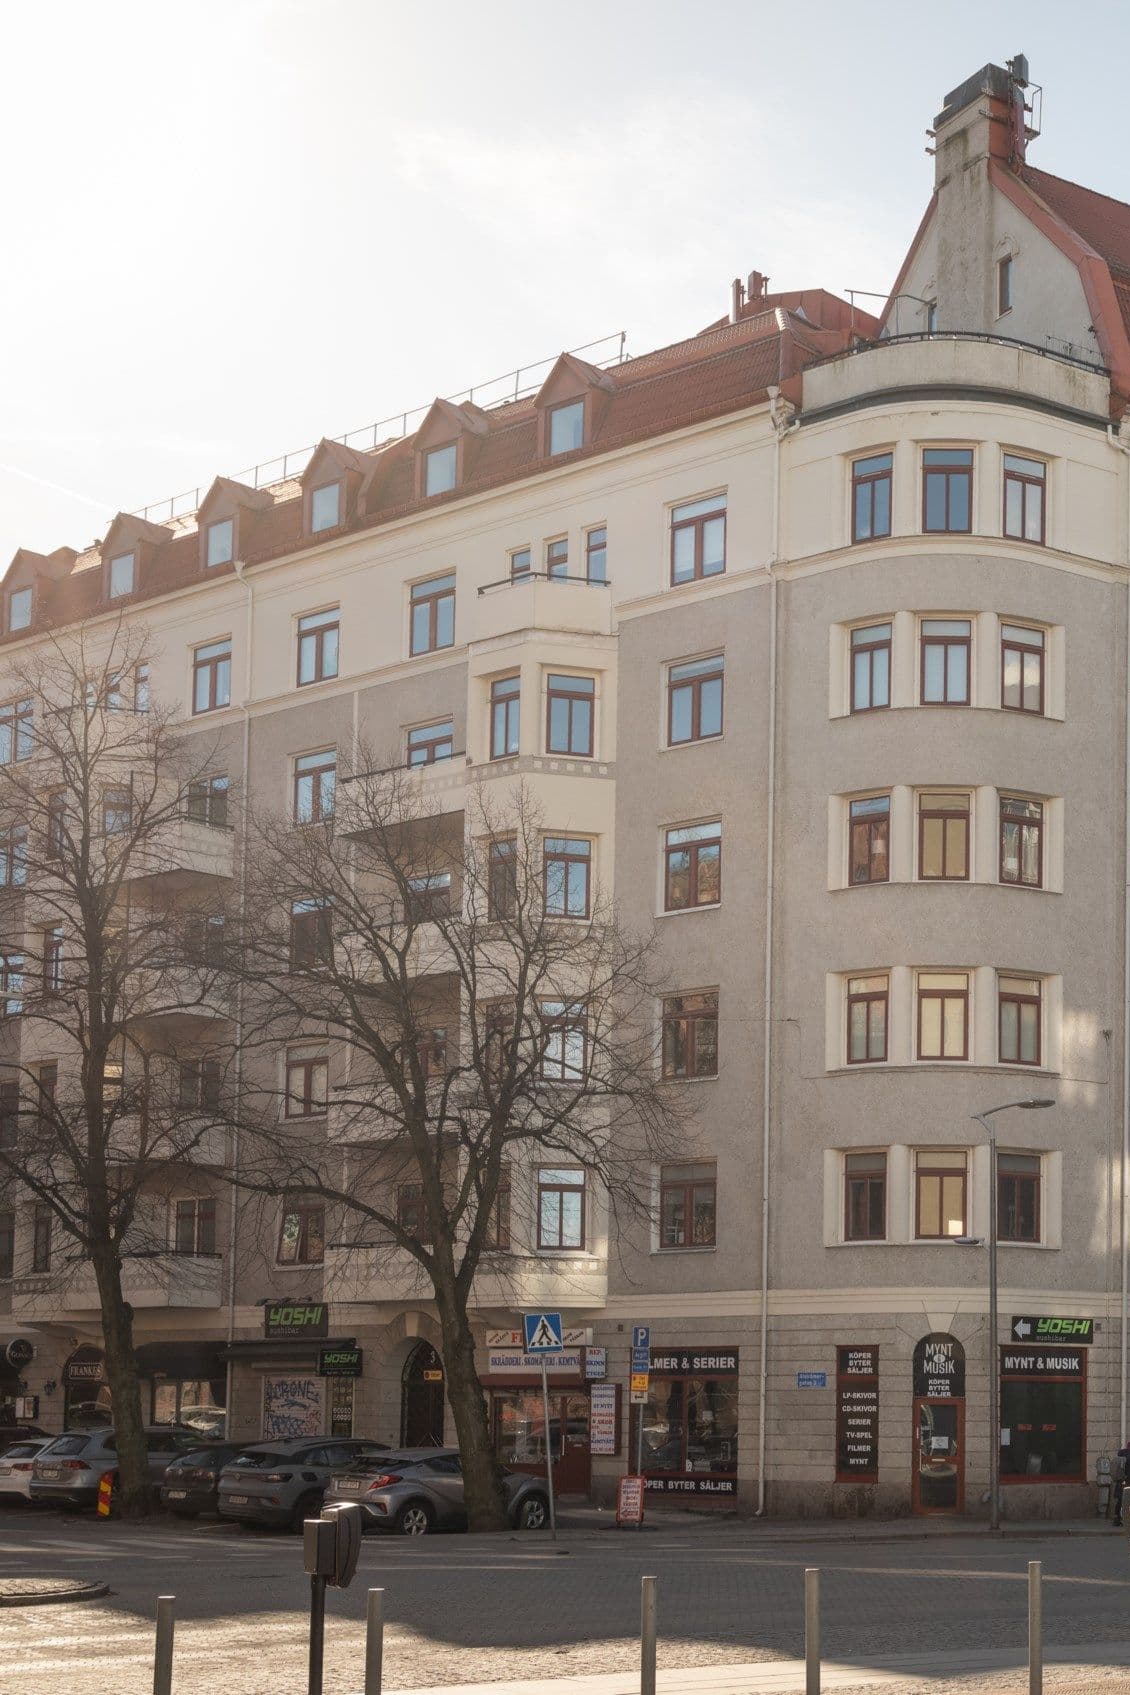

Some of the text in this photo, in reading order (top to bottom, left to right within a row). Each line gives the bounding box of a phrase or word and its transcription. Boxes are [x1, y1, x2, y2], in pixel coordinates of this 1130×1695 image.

[269, 1307, 322, 1325] YOSHI
[1036, 1319, 1090, 1334] YOSHI
[637, 1329, 647, 1346] P
[926, 1343, 953, 1357] MYNT
[323, 1353, 359, 1363] YOSHI
[491, 1354, 521, 1366] SKRÄDDERI
[524, 1357, 556, 1366] SKOMAERI
[649, 1358, 679, 1369] LMER
[681, 1358, 690, 1369] &
[693, 1357, 735, 1369] SERIER
[1005, 1357, 1079, 1369] MYNT & MUSIK
[923, 1360, 954, 1373] MUSIK
[669, 1480, 695, 1490] BYTER
[700, 1480, 732, 1491] SÄLJER
